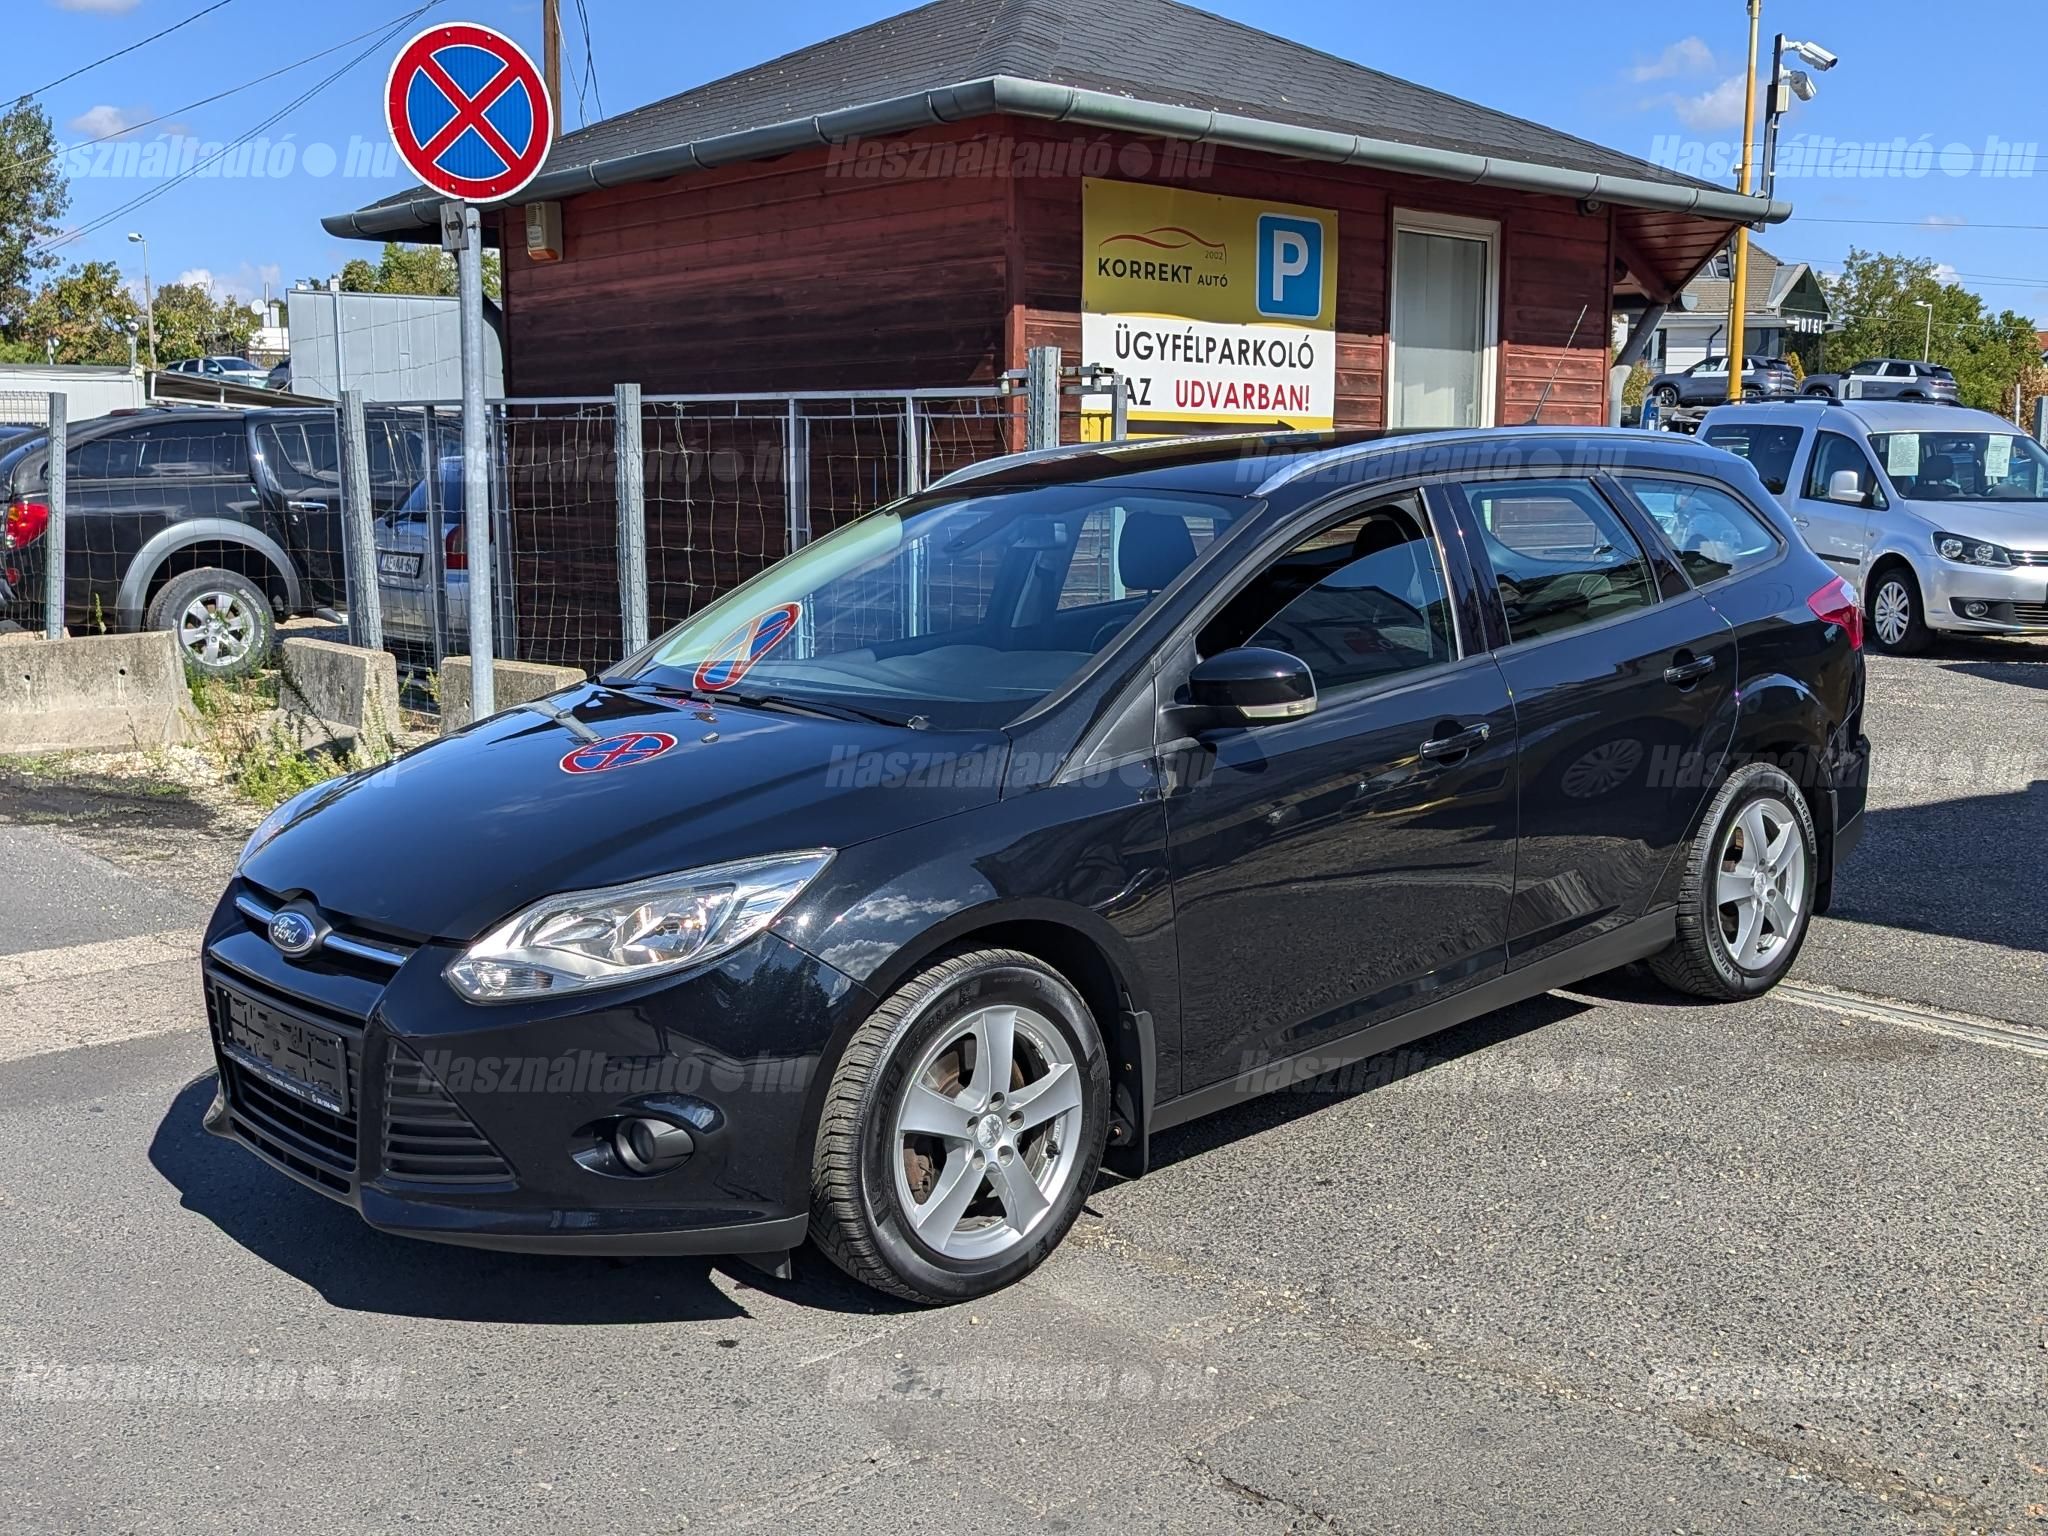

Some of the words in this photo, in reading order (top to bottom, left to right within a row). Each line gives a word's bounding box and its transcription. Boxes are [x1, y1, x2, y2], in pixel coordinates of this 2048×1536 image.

[1205, 250, 1224, 261] 2002
[1272, 229, 1309, 302] P
[1098, 257, 1193, 284] KORREKT
[1197, 273, 1228, 288] AUTÓ
[1115, 323, 1314, 370] ÜGYFÉLPARKOLÓ
[1125, 377, 1152, 406] AZ
[1175, 379, 1310, 412] UDVARBAN!
[273, 916, 301, 943] Ford
